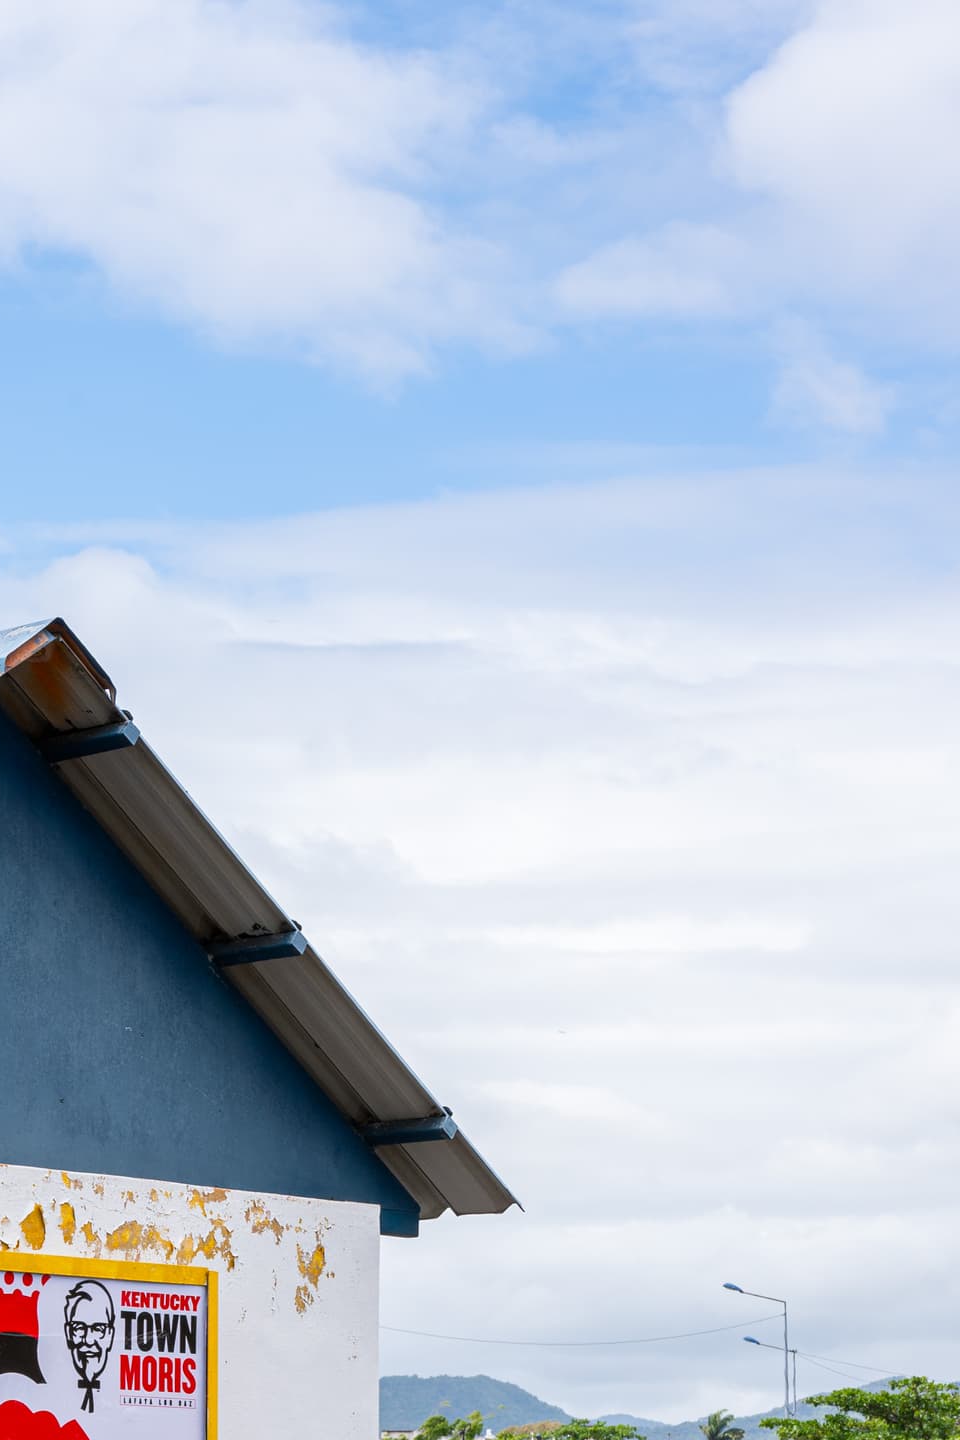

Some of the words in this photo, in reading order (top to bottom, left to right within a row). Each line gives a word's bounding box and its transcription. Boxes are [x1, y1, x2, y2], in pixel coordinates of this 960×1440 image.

[121, 1290, 200, 1311] KENTUCKY
[121, 1311, 197, 1354] TOWN
[120, 1355, 196, 1394] MORIS
